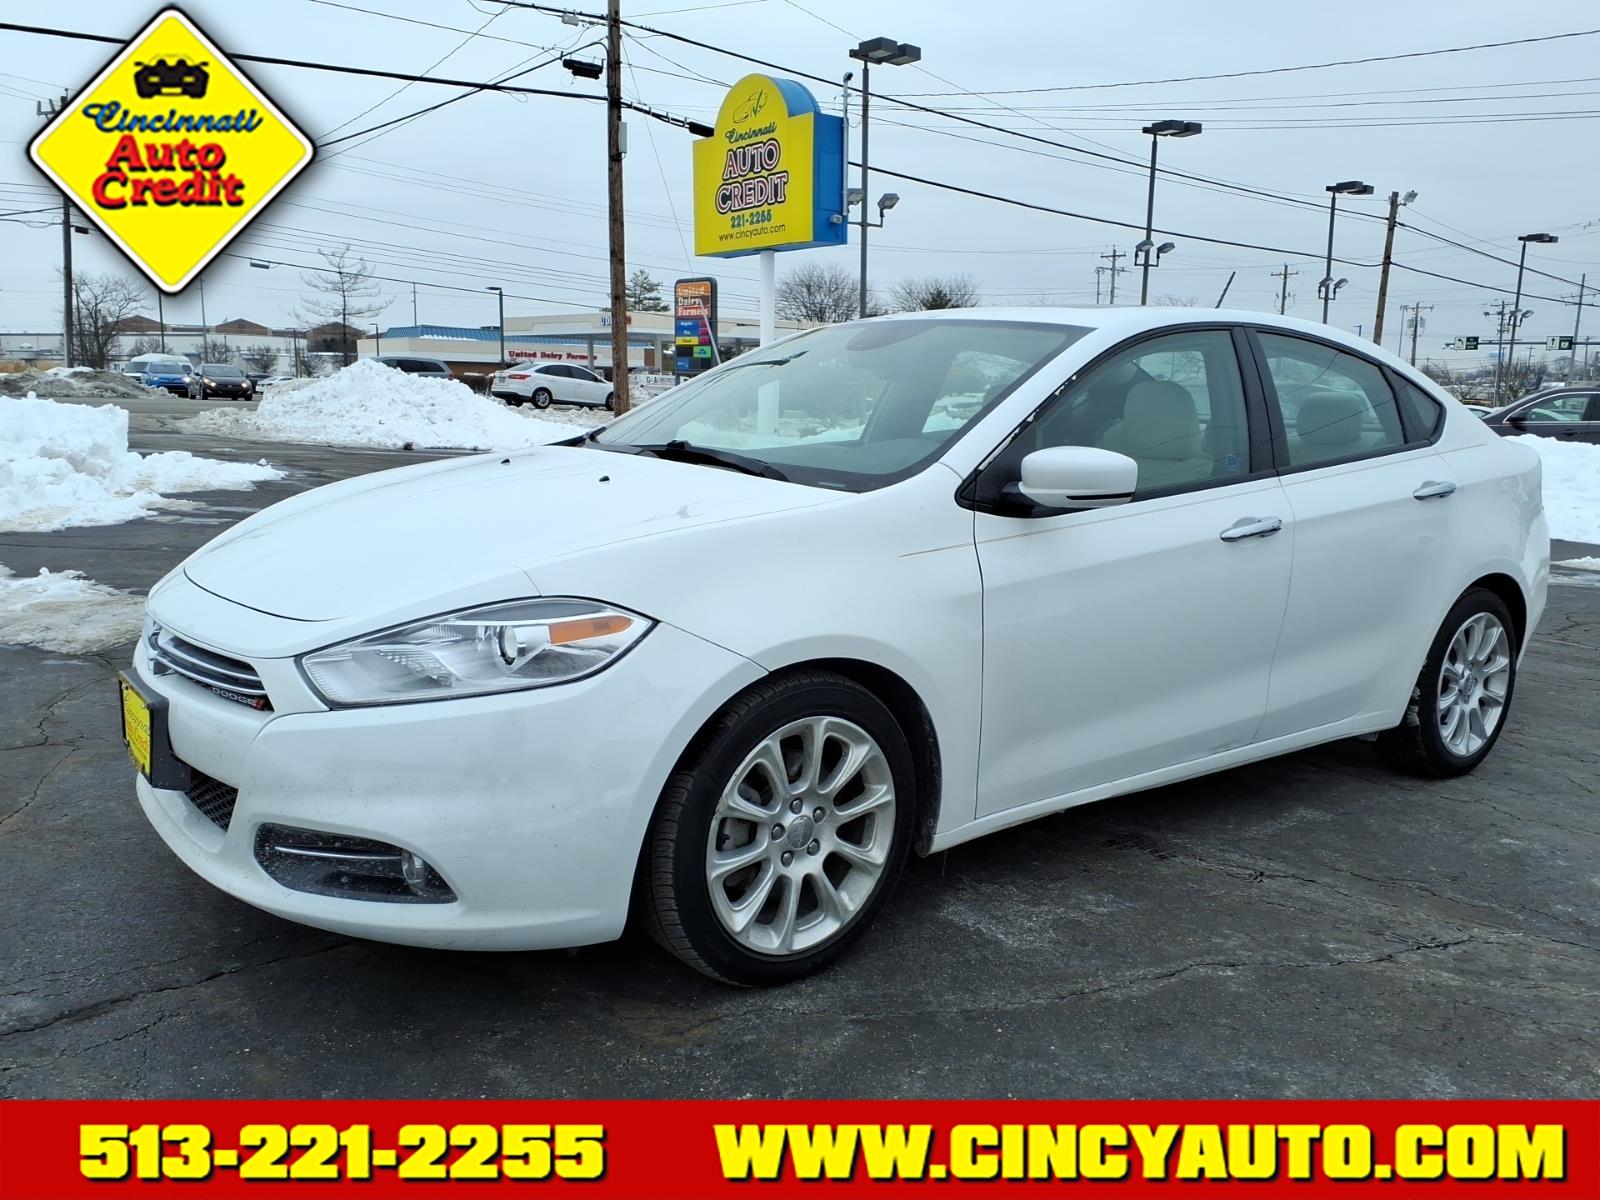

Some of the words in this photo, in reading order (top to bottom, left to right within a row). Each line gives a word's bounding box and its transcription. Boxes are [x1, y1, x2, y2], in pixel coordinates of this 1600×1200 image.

[725, 122, 777, 143] Cincinnati
[723, 139, 780, 180] AUTO
[716, 172, 788, 215] CREDIT
[719, 224, 786, 242] www.cincyauto.com
[678, 286, 705, 296] United
[508, 350, 538, 359] United
[540, 351, 563, 361] Dairy
[566, 352, 598, 361] Farmes
[212, 687, 257, 707] DODGE
